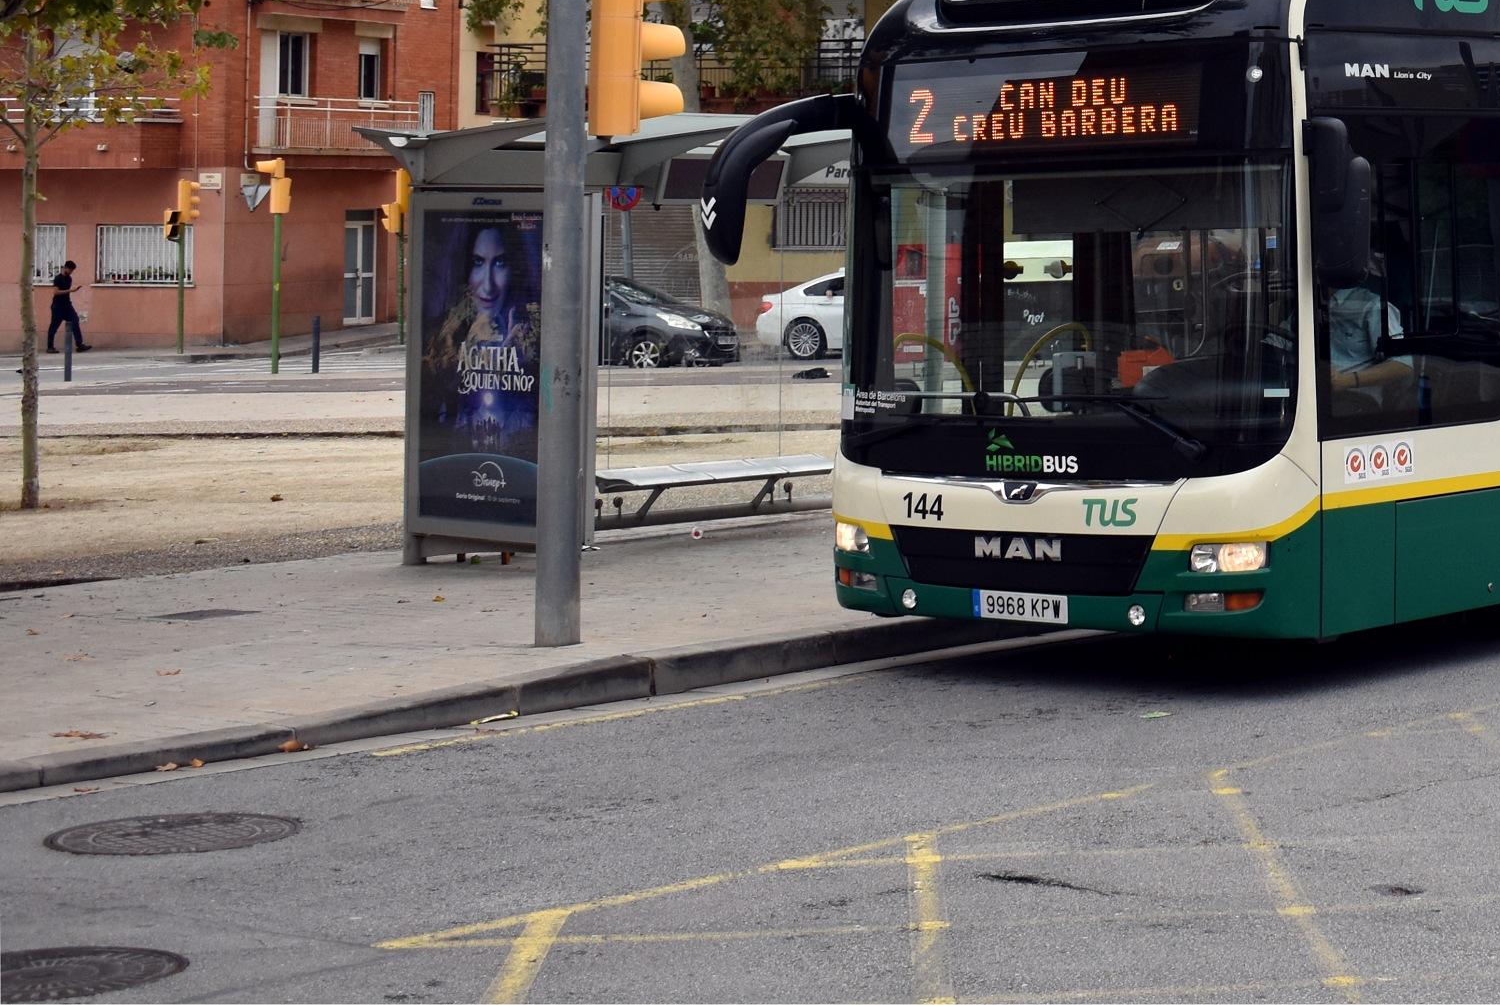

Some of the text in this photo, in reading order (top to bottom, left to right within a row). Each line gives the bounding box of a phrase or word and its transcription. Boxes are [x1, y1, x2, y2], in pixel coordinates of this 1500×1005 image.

[1344, 62, 1390, 78] MAN
[1416, 71, 1432, 81] City
[1000, 77, 1126, 111] CAN DEU
[909, 89, 934, 143] 2
[953, 104, 1178, 142] CREU BARBERA
[456, 341, 524, 376] AGATHA,
[513, 375, 535, 392] NO?
[985, 454, 1079, 474] HIBRIDBUS
[903, 491, 944, 521] 144
[1082, 498, 1138, 527] TUS
[974, 536, 1062, 562] MAN
[986, 595, 1061, 619] 9968 KPW
